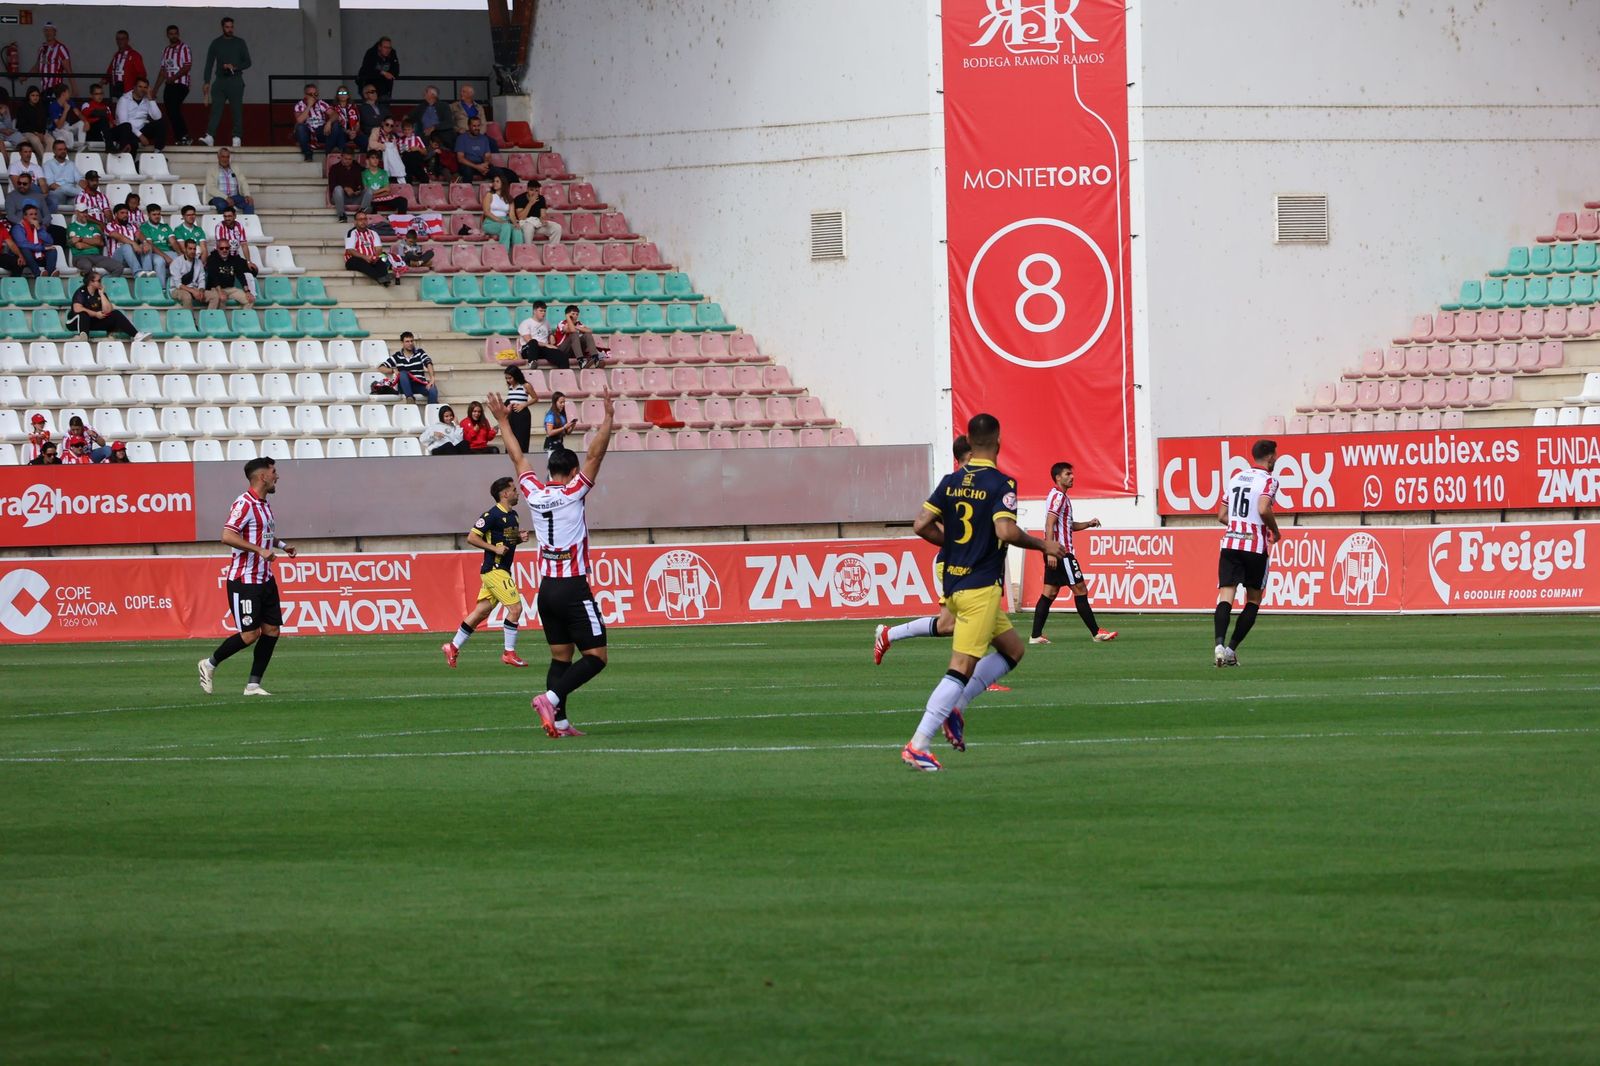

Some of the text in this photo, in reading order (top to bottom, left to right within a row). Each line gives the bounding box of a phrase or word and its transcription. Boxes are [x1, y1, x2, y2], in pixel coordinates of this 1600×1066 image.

[963, 52, 1105, 69] BODEGA RAMON RAMOS
[963, 165, 1112, 190] MONTETORO
[1015, 252, 1066, 333] 8
[1341, 434, 1520, 467] www.cubiex.es
[1163, 441, 1336, 511] cubex
[1394, 474, 1505, 505] 675 630 110
[945, 486, 987, 500] LANCHO
[1232, 486, 1251, 518] 16
[954, 501, 974, 545] 3
[1458, 528, 1586, 581] Freigel
[55, 586, 92, 601] COPE
[745, 550, 933, 611] ZAMORA
[1082, 573, 1178, 606] ZAMORA
[1454, 587, 1583, 600] A GOODLIFE FOODS COMPANY
[57, 602, 118, 617] ZAMORA
[125, 595, 173, 610] COPE.es
[240, 599, 253, 614] 10
[279, 598, 429, 633] ZAMORA
[58, 617, 98, 627] 1269 OM
